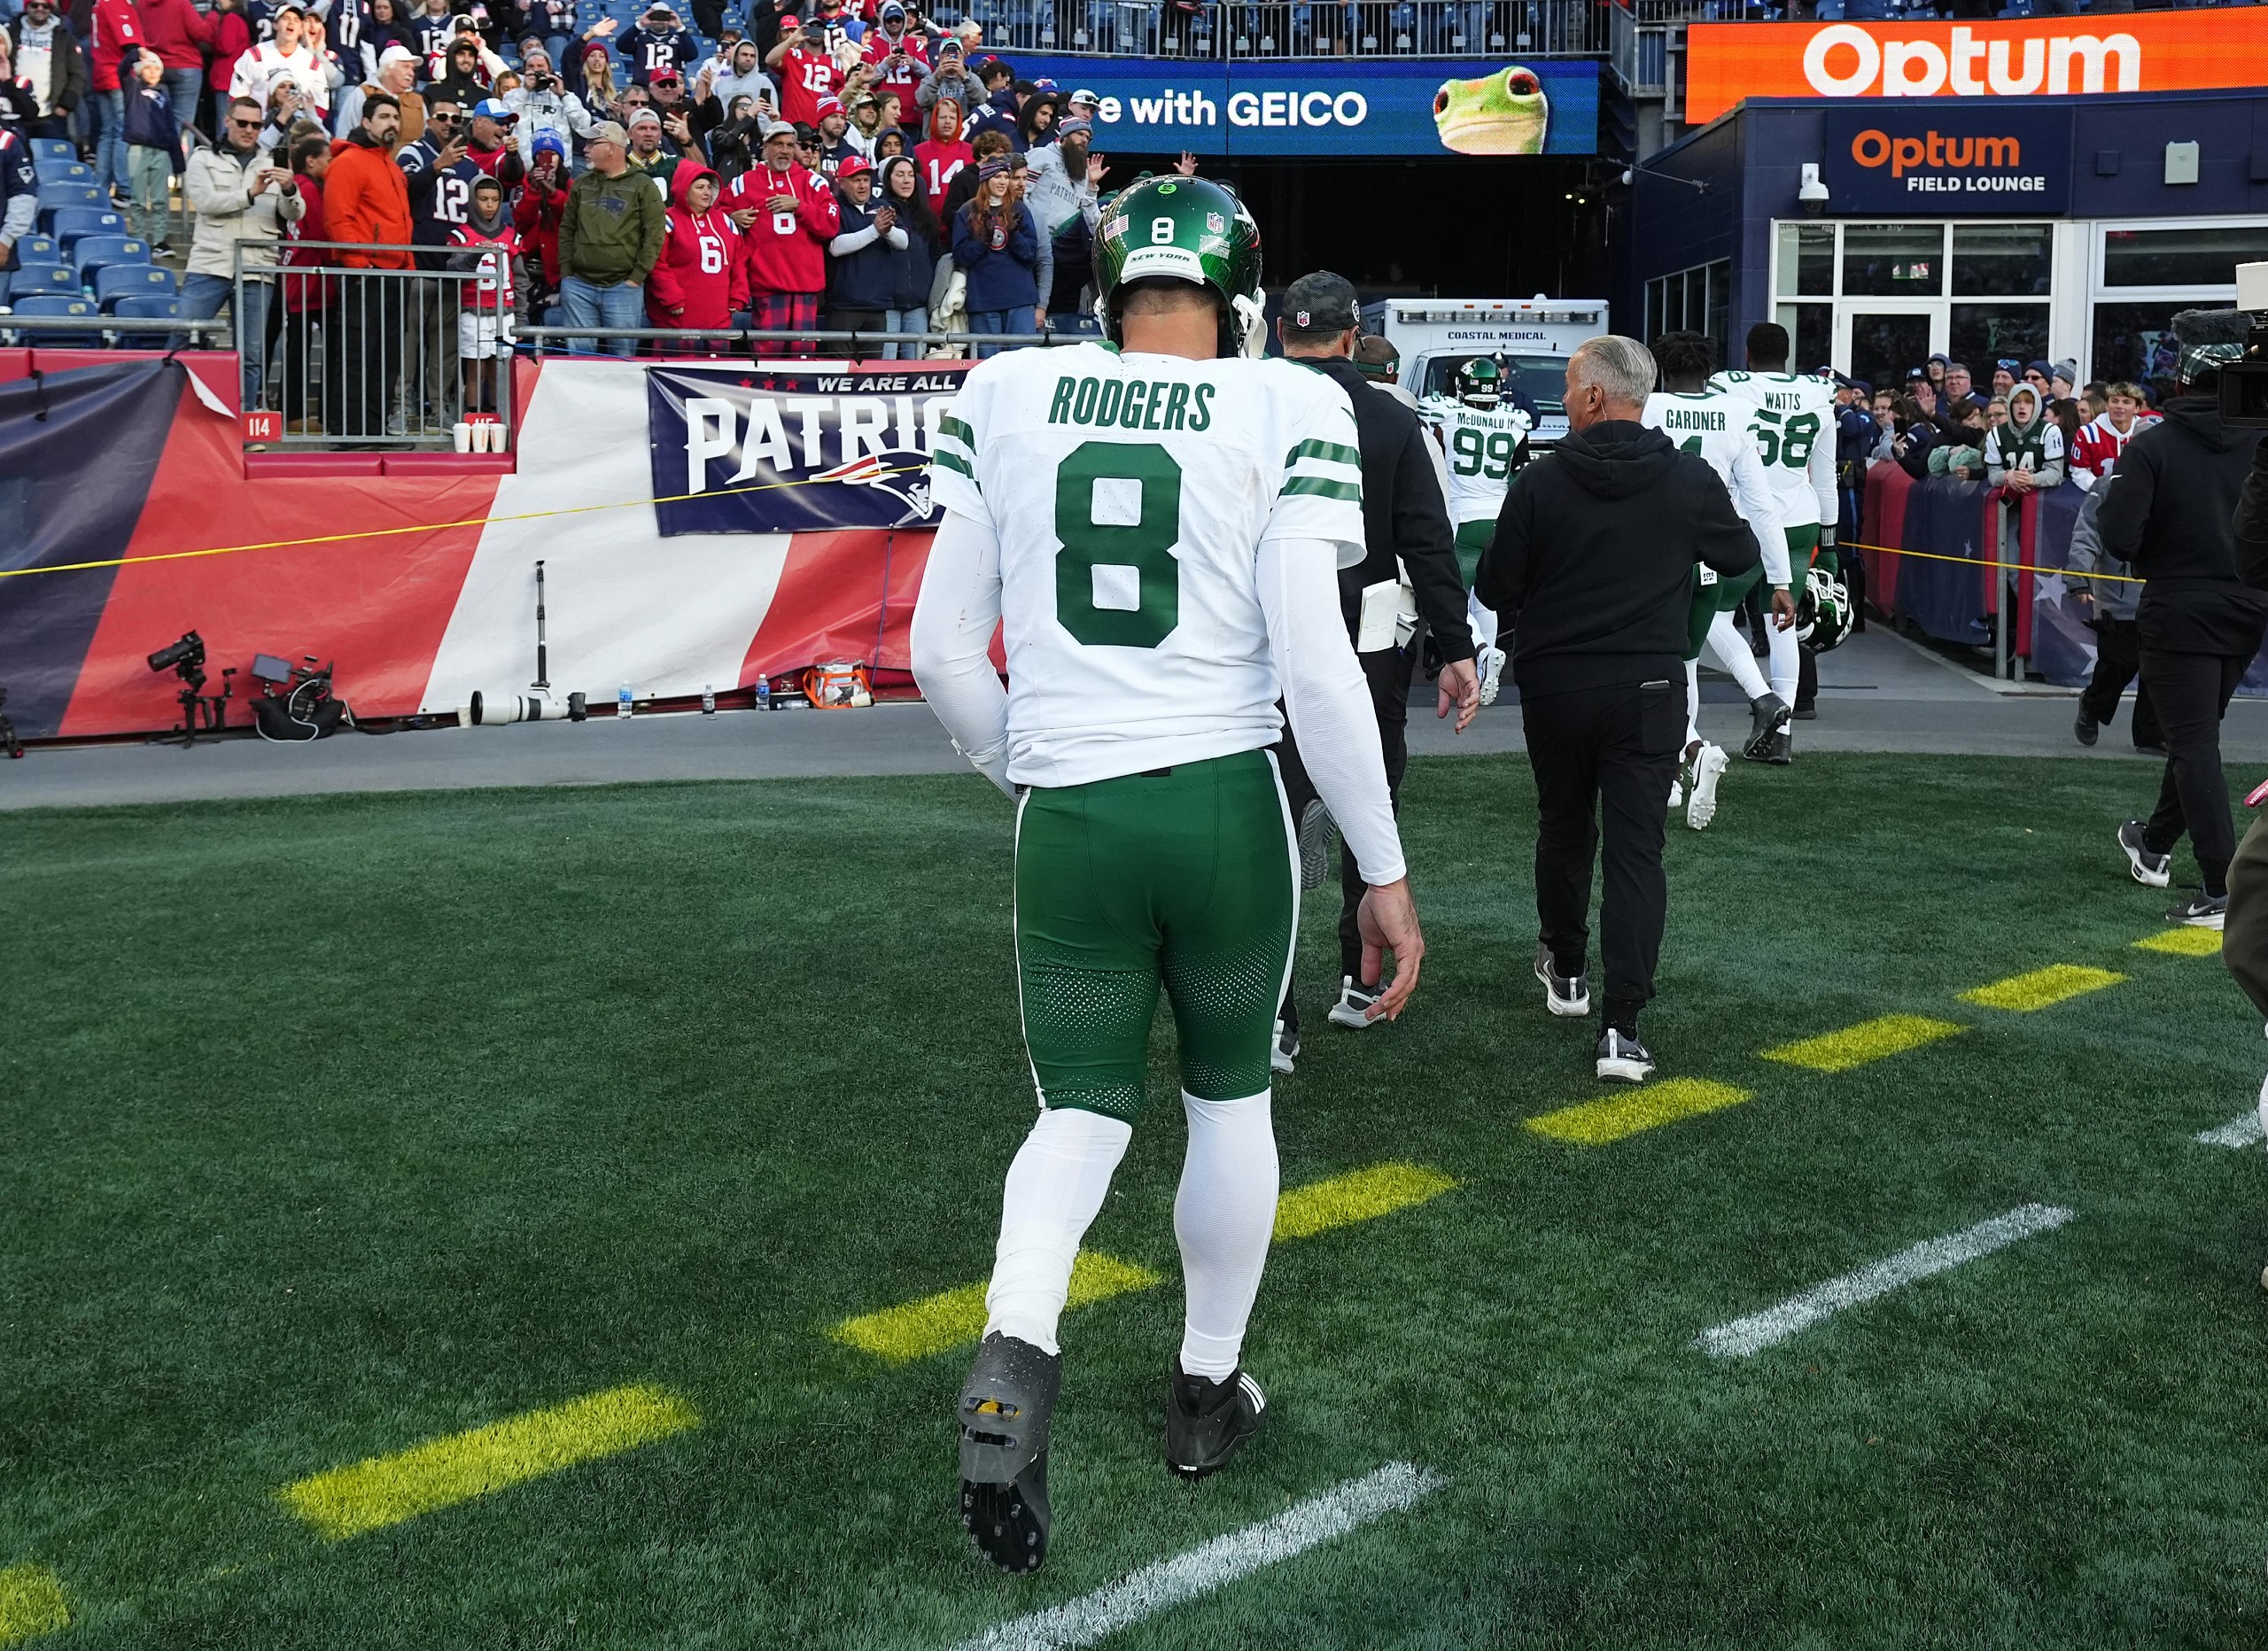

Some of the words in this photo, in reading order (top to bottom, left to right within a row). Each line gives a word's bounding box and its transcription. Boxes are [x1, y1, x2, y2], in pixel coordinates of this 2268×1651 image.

[420, 29, 447, 54] 12
[823, 27, 848, 55] 12
[644, 43, 674, 70] 12
[1803, 23, 2141, 97] Optum
[802, 63, 832, 93] 12
[886, 65, 913, 84] 12
[1130, 89, 1216, 125] with
[1227, 91, 1368, 127] GEICO
[1851, 129, 2020, 177] Optum
[928, 159, 965, 195] 14
[1907, 177, 1961, 191] FIELD
[1966, 176, 2046, 191] LOUNGE
[432, 176, 470, 224] 12
[1151, 217, 1175, 244] 8
[698, 236, 722, 275] 6
[1130, 252, 1155, 263] NEW
[1159, 252, 1192, 263] YORK
[1448, 331, 1495, 340] COASTAL
[1498, 331, 1547, 340] MEDICAL
[817, 376, 852, 392] WE
[858, 376, 908, 391] ARE
[912, 375, 956, 391] ALL
[1480, 384, 1494, 392] 99
[1047, 376, 1216, 432] RODGERS
[1765, 391, 1801, 410] WATTS
[249, 417, 270, 437] 114
[1666, 409, 1726, 431] GARDNER
[1757, 408, 1821, 468] 58
[2052, 438, 2062, 449] 14
[1453, 427, 1516, 480] 99
[2005, 451, 2037, 474] 14
[1056, 441, 1183, 647] 8
